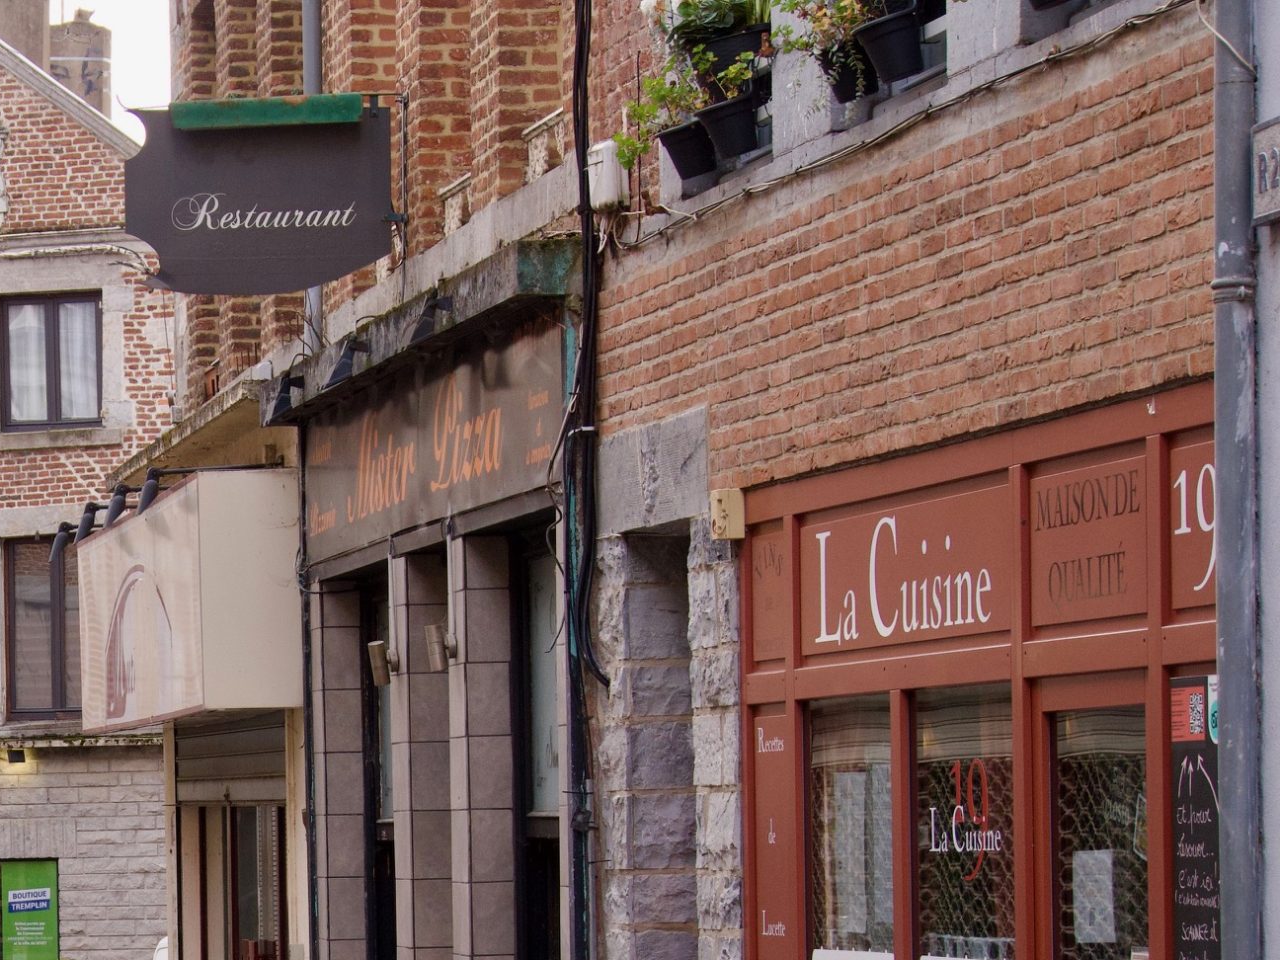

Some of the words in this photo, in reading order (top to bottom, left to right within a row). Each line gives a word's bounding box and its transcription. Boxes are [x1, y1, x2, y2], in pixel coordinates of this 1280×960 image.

[172, 193, 357, 231] Restaurant
[347, 409, 417, 525] Mister
[430, 374, 504, 493] Pizza
[1035, 476, 1110, 532] MAISON
[1113, 469, 1140, 517] DE
[1173, 463, 1217, 592] 19
[815, 531, 860, 646] La
[869, 515, 992, 638] Cuisine
[1048, 542, 1128, 616] QUALITÉ
[929, 807, 949, 854] La
[952, 804, 1002, 853] Cuisine
[950, 758, 989, 881] 19
[11, 900, 48, 911] TREMPLIN
[12, 890, 48, 900] BOUTIQUE
